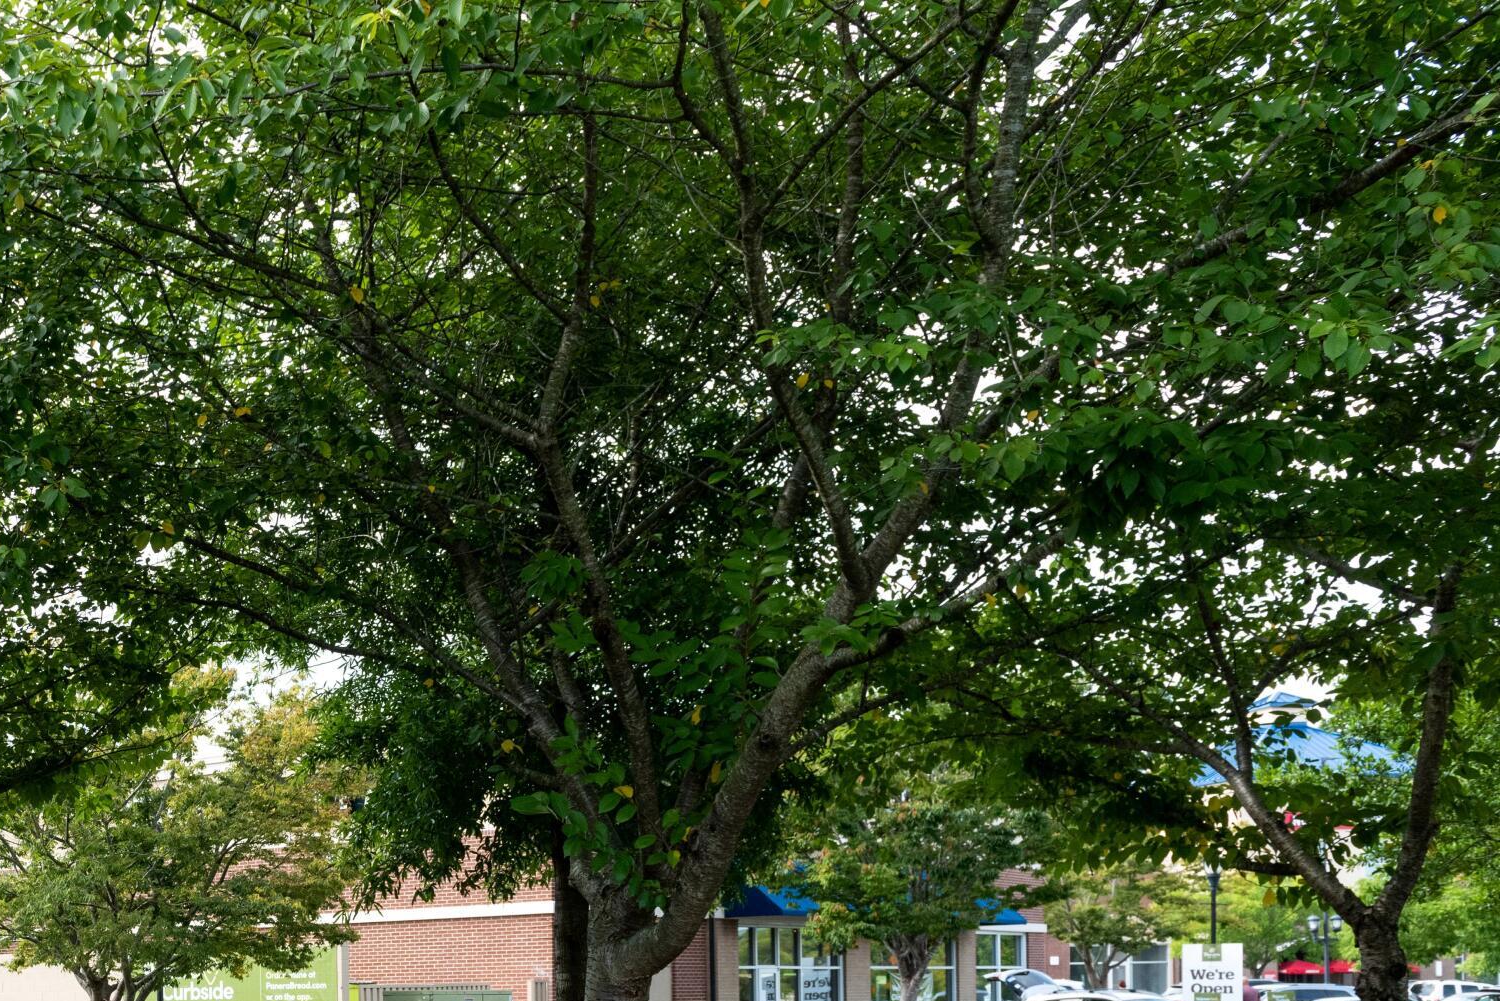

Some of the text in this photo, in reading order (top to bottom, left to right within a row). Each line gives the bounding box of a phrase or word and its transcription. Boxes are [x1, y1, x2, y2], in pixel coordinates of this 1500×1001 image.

[308, 971, 316, 979] at
[1190, 969, 1235, 980] We're
[163, 980, 234, 1001] Curbside
[266, 981, 327, 990] PaneraBread.com
[1190, 983, 1234, 994] Open
[283, 993, 295, 1001] the
